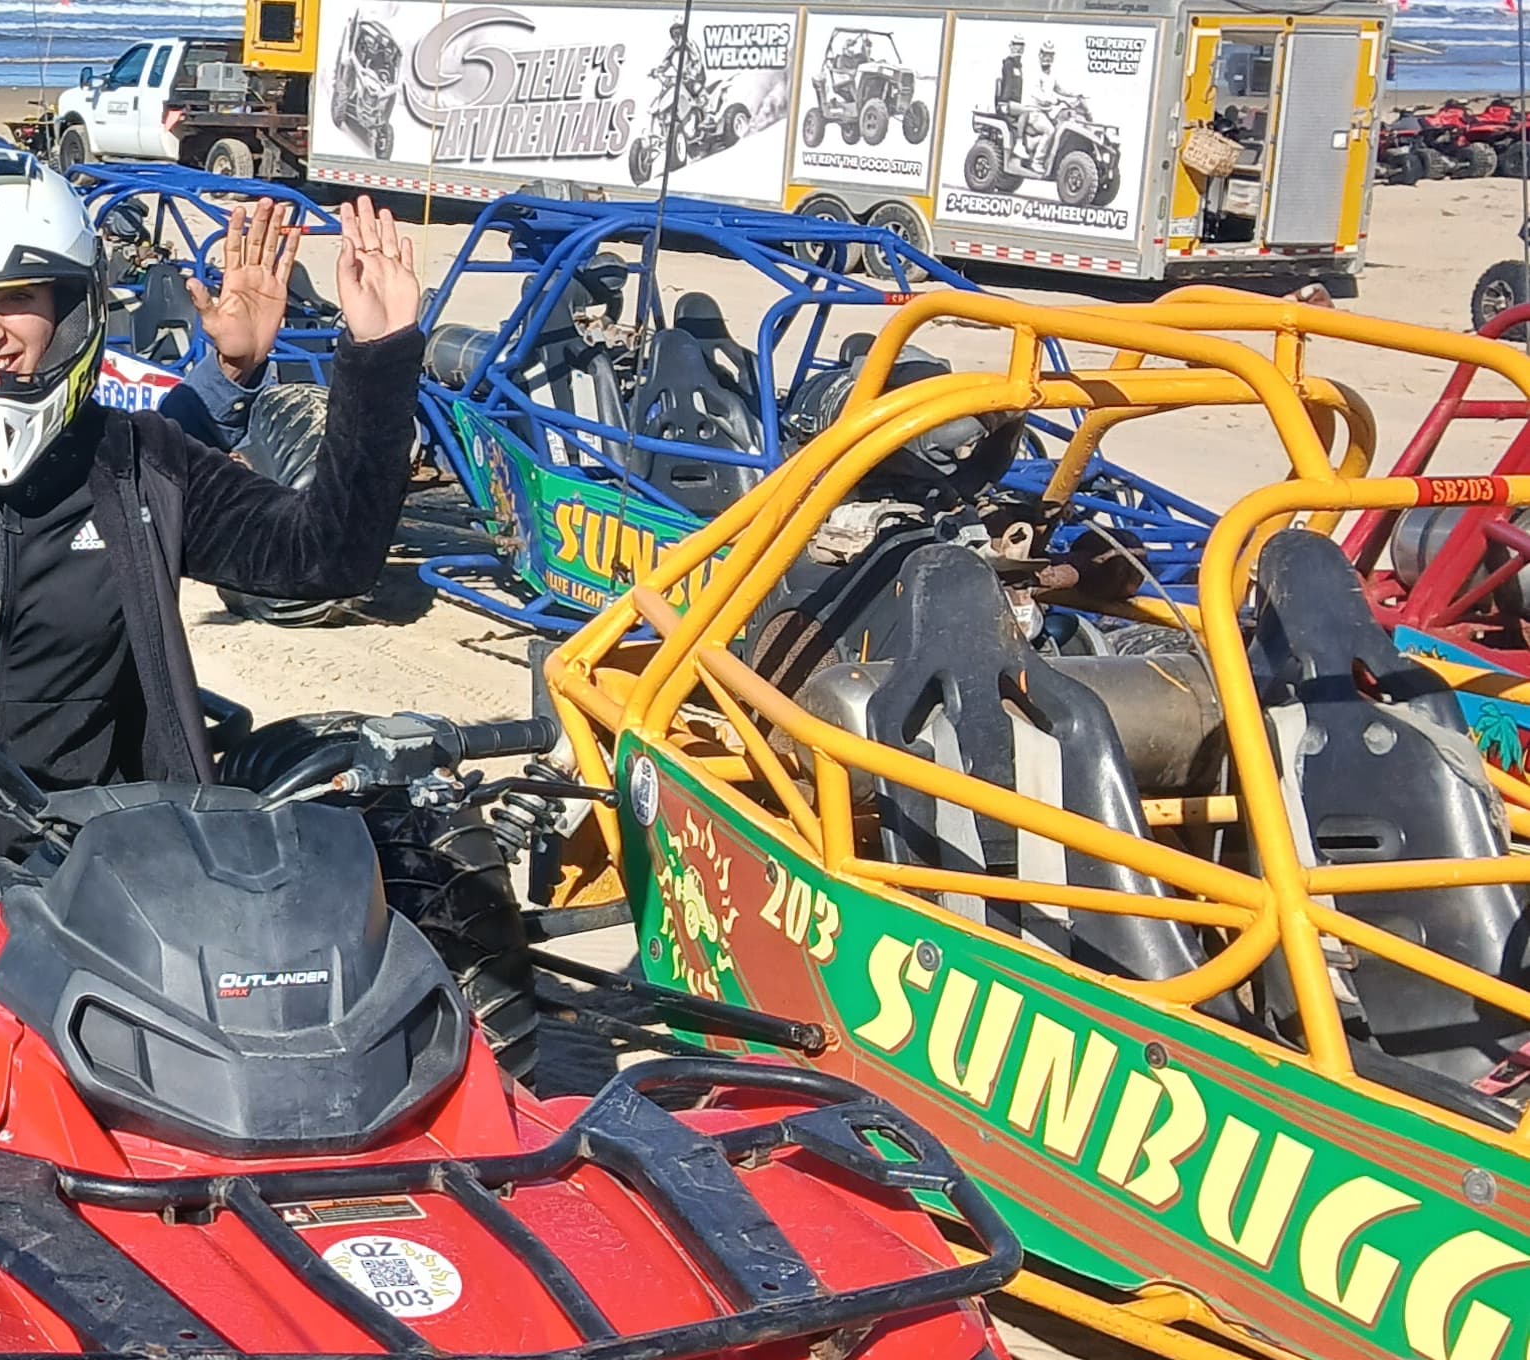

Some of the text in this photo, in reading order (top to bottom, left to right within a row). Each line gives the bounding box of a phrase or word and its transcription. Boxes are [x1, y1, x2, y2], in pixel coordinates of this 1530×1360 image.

[704, 24, 790, 47] WALK-UPS
[1107, 37, 1146, 51] PERFECT
[705, 46, 788, 69] WELCOME
[1089, 49, 1118, 61] QUAD
[435, 99, 636, 162] ATV RENTALS
[859, 156, 890, 172] GOOD
[946, 193, 1012, 216] 2-PERSON
[1084, 207, 1127, 229] DRIVE
[1431, 478, 1494, 503] SB203
[759, 854, 840, 961] 203
[349, 1242, 399, 1258] QZ
[374, 1289, 434, 1308] 003
